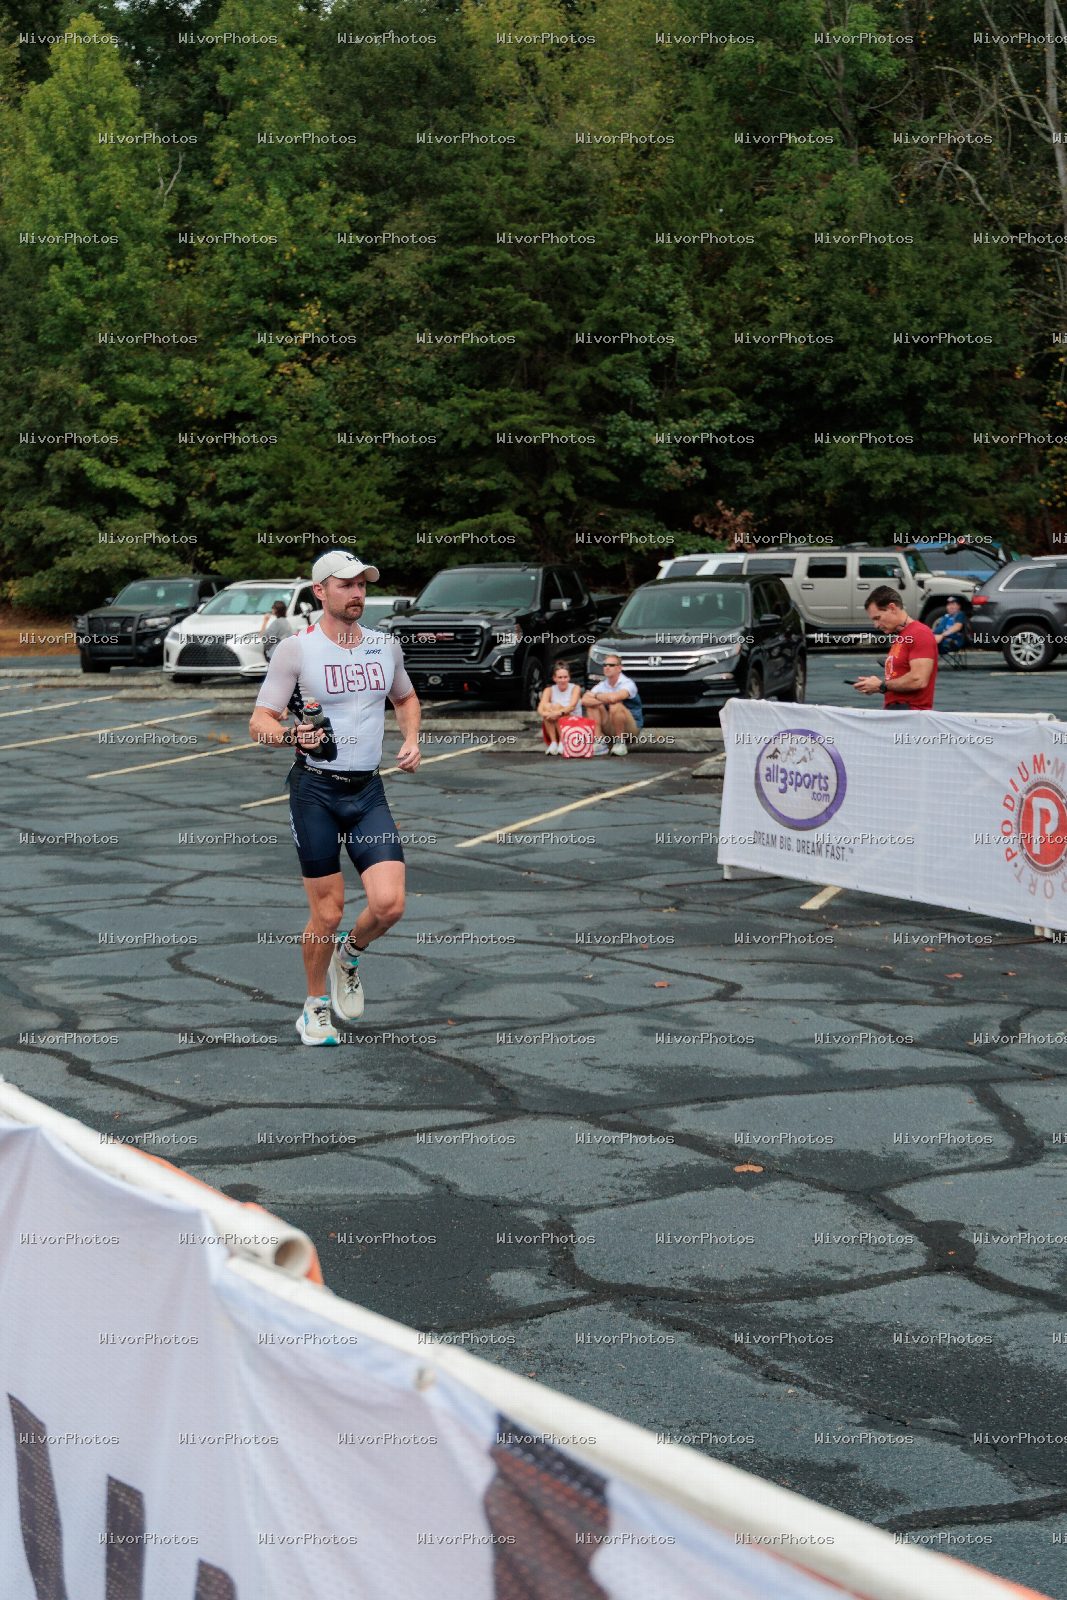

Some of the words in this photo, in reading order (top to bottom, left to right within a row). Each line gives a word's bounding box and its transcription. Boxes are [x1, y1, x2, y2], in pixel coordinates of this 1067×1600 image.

[324, 662, 386, 694] USA
[765, 764, 829, 794] all3sports
[1001, 752, 1046, 863] PODIUM
[1032, 796, 1059, 855] P
[753, 830, 777, 848] DREAM
[779, 835, 794, 852] BIG.
[796, 838, 823, 857] DREAM
